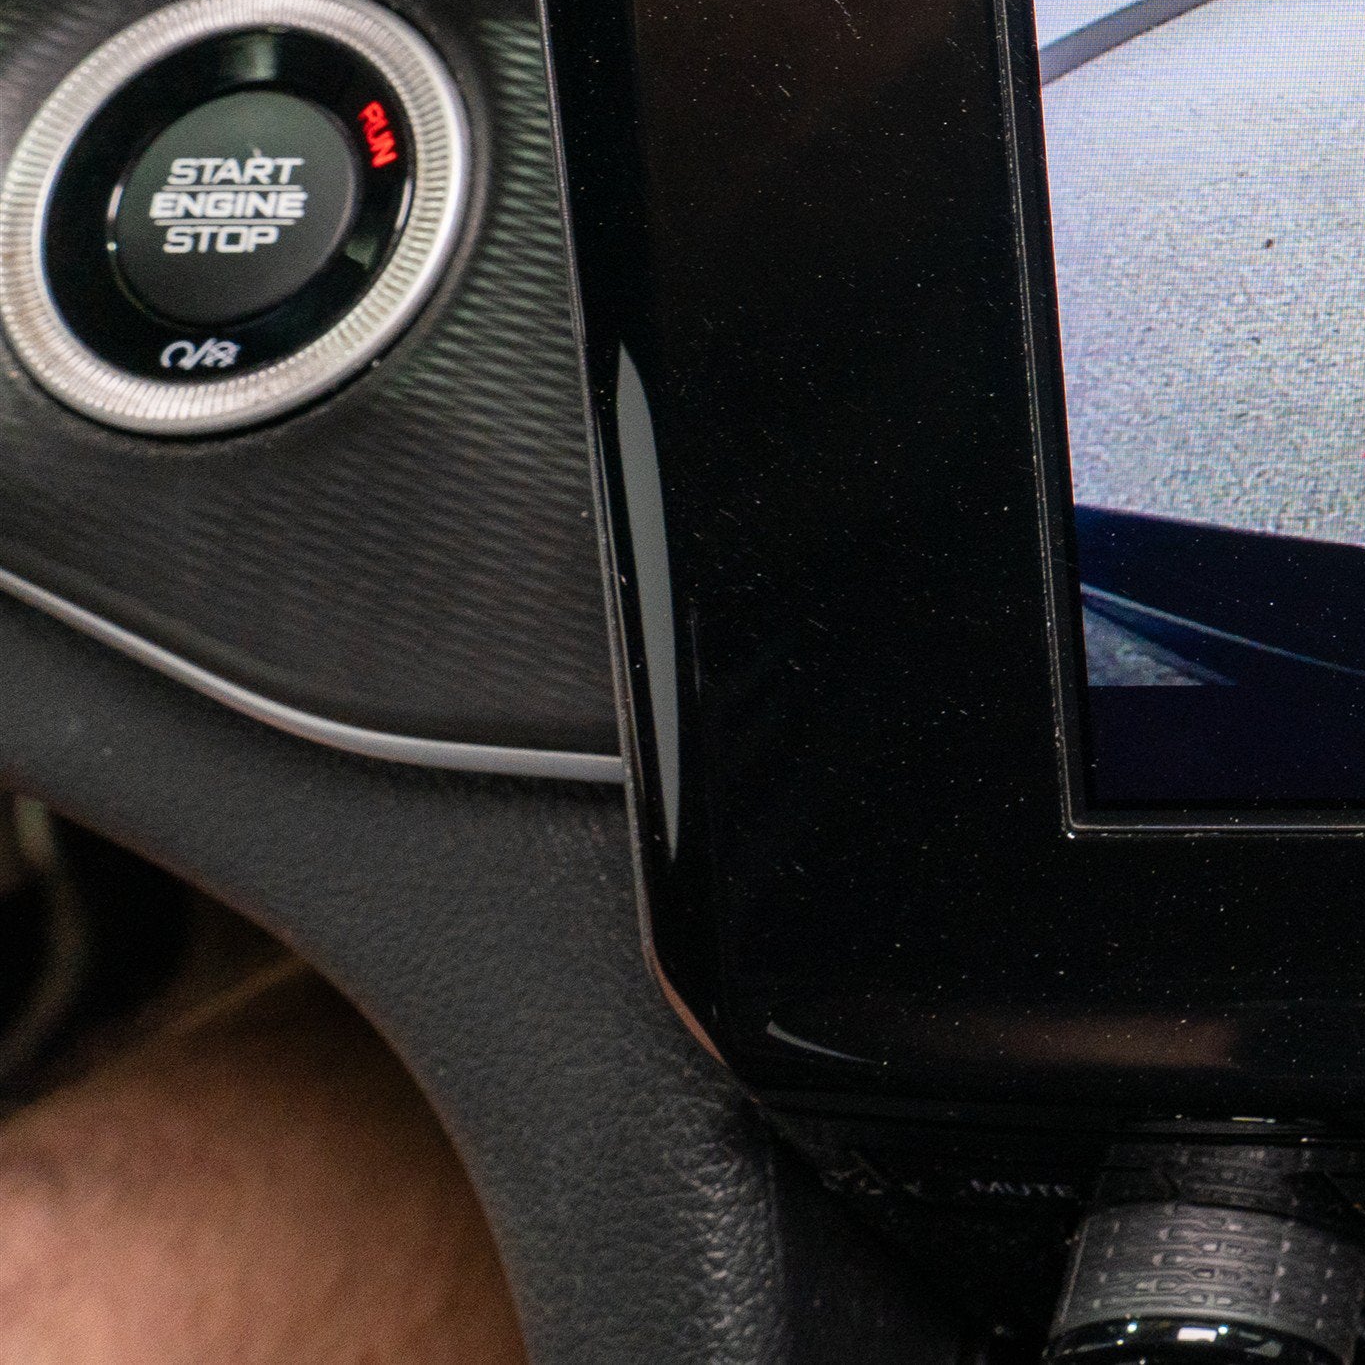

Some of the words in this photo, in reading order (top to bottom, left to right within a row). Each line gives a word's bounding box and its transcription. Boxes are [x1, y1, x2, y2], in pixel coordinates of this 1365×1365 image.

[358, 100, 398, 168] RUN
[167, 157, 305, 185] START
[149, 191, 308, 219] ENGINE
[163, 225, 279, 254] STOP
